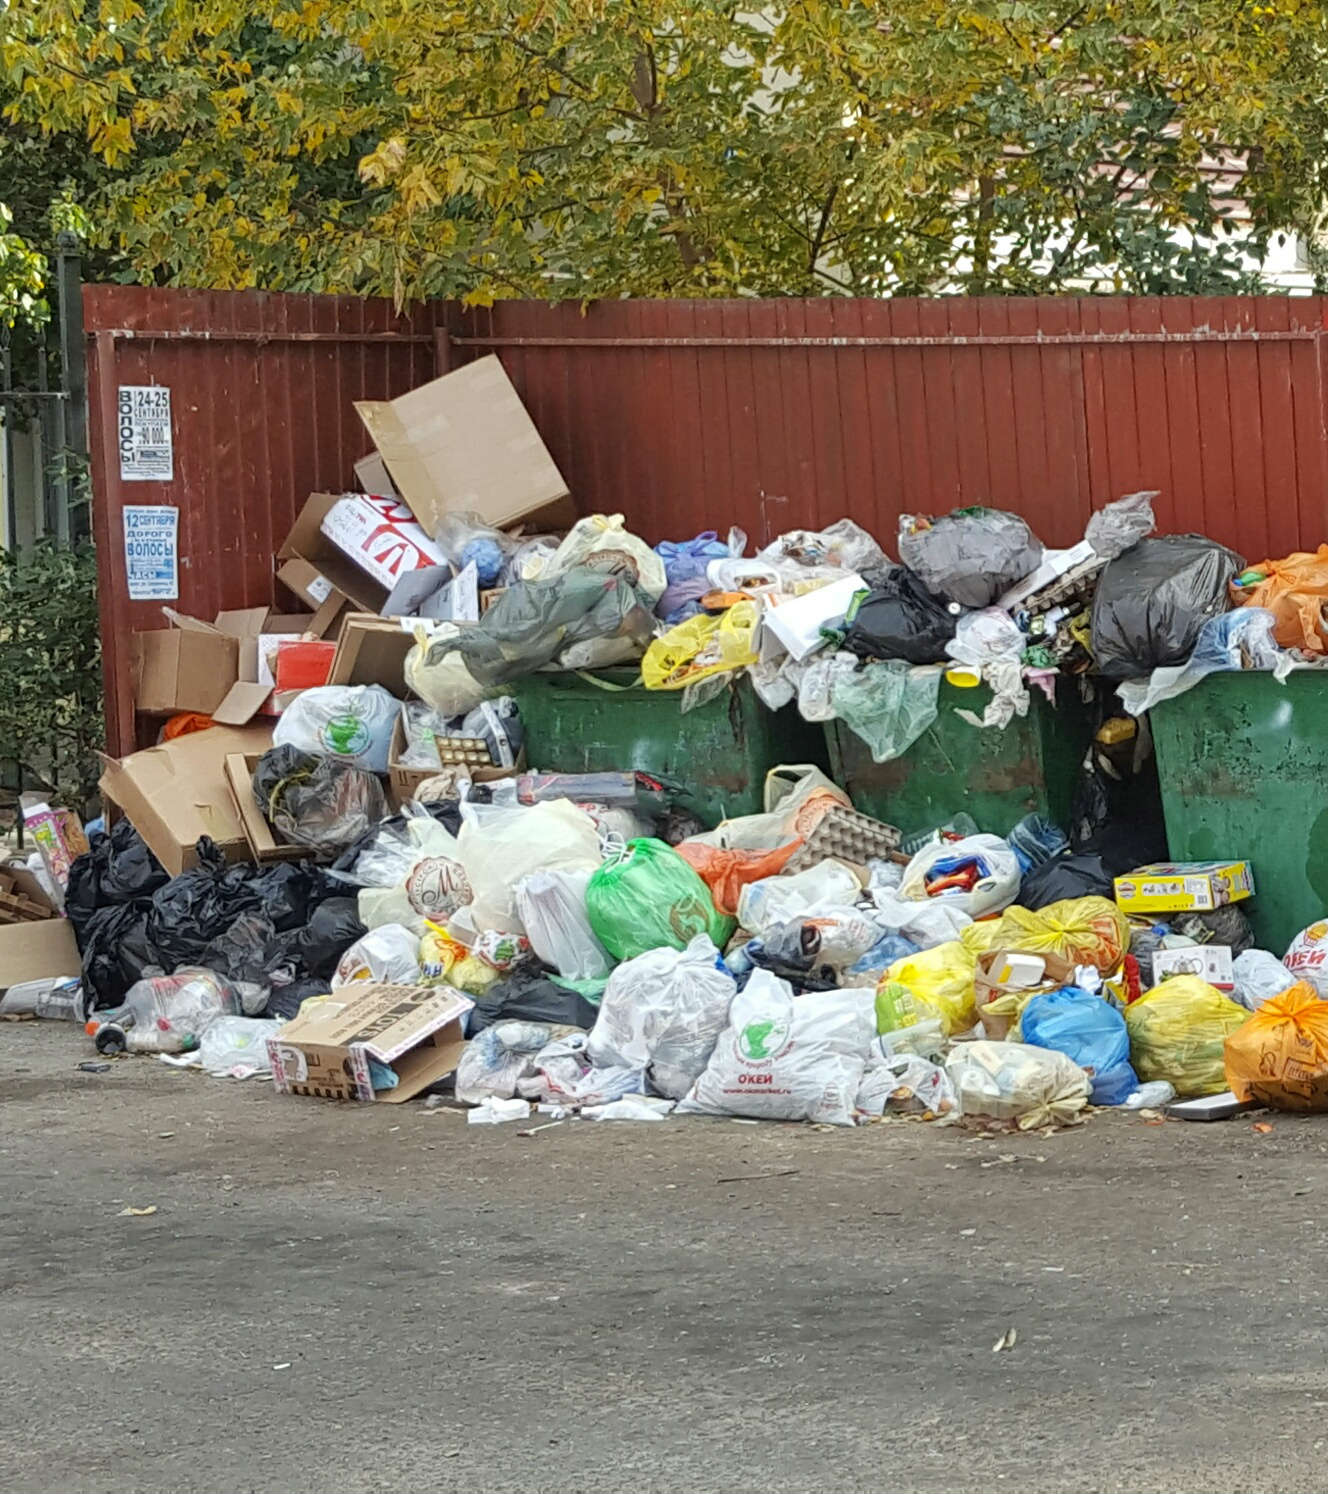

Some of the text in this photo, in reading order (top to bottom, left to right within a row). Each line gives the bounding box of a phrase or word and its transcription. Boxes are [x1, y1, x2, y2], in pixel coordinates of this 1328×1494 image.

[138, 391, 168, 407] 24-25
[134, 408, 168, 418] СЕНТЯБРЯ
[127, 514, 175, 528] 12 СЕНТЯБРЯ
[128, 543, 173, 556] ВОЛОСЫ
